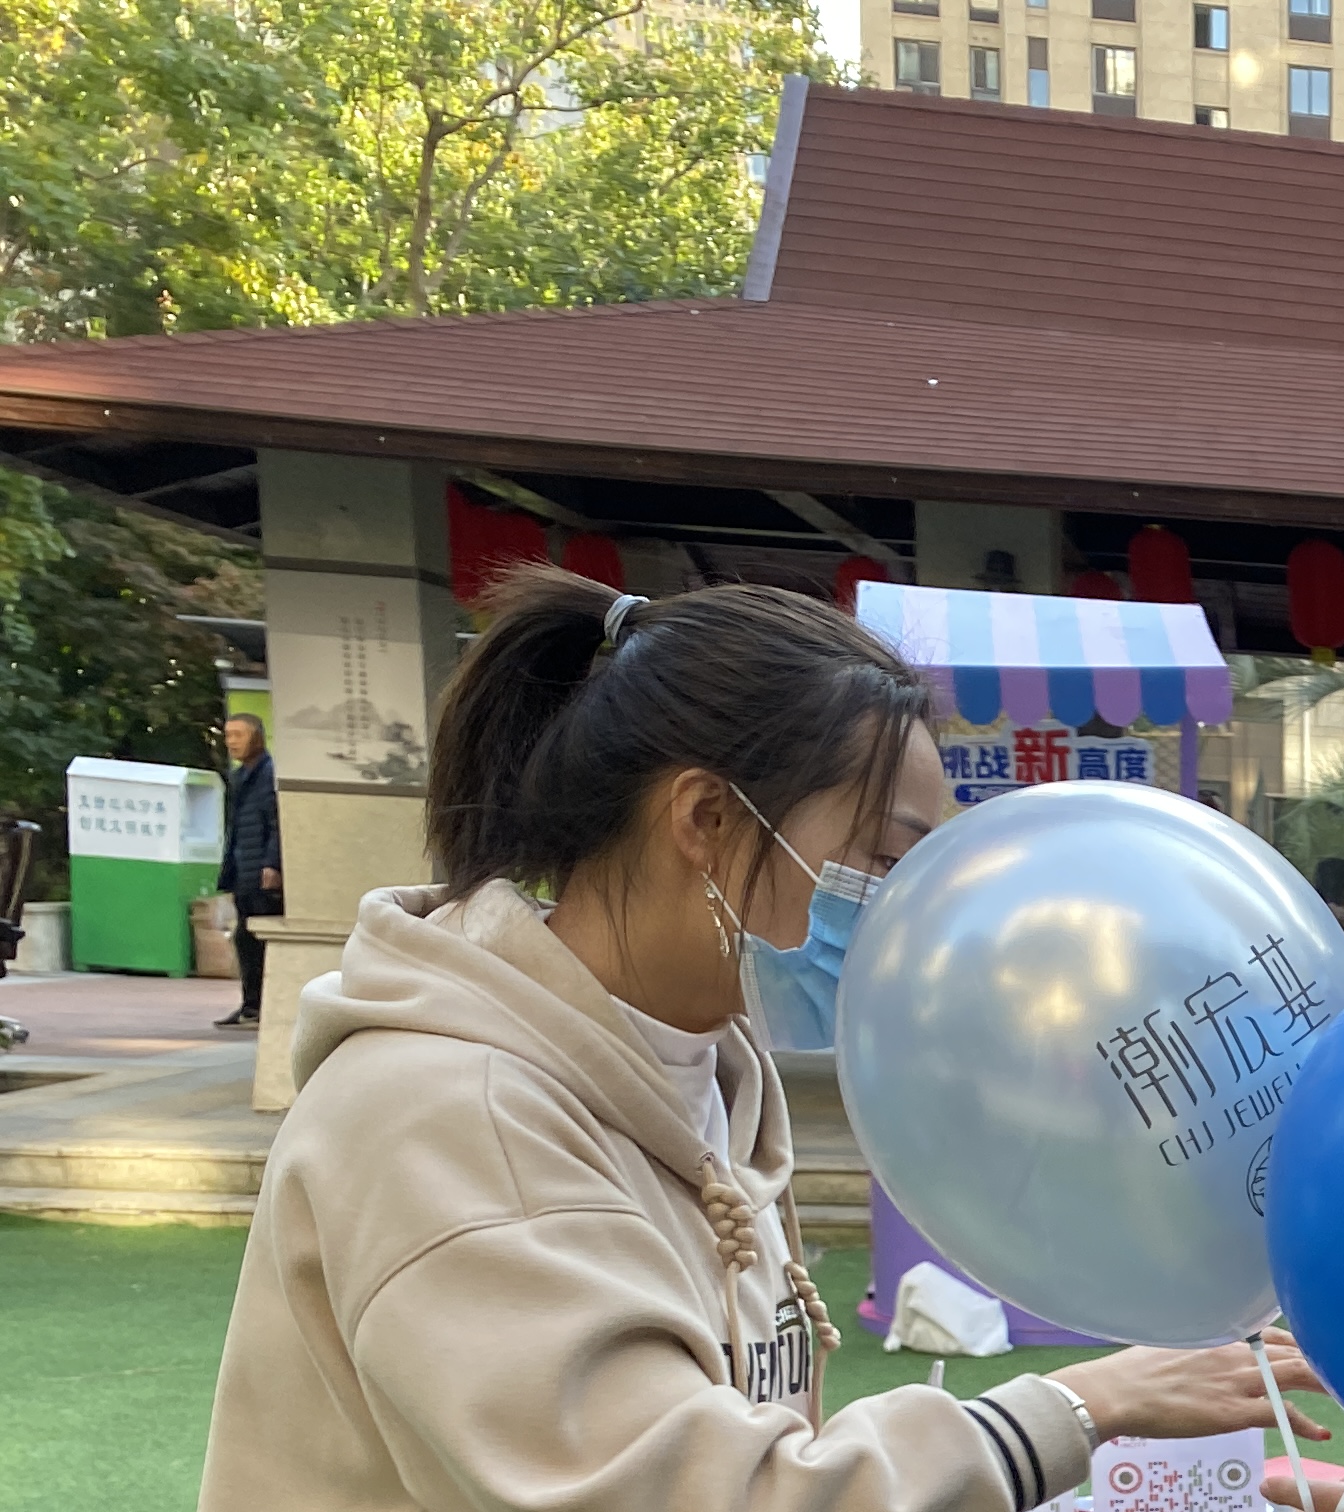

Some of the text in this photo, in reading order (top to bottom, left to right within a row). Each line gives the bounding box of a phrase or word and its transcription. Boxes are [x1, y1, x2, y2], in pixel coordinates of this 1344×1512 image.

[941, 727, 1148, 782] 挑战新高度
[1096, 934, 1331, 1129] 潮宏基
[1158, 1062, 1302, 1167] CHJ JEWE
